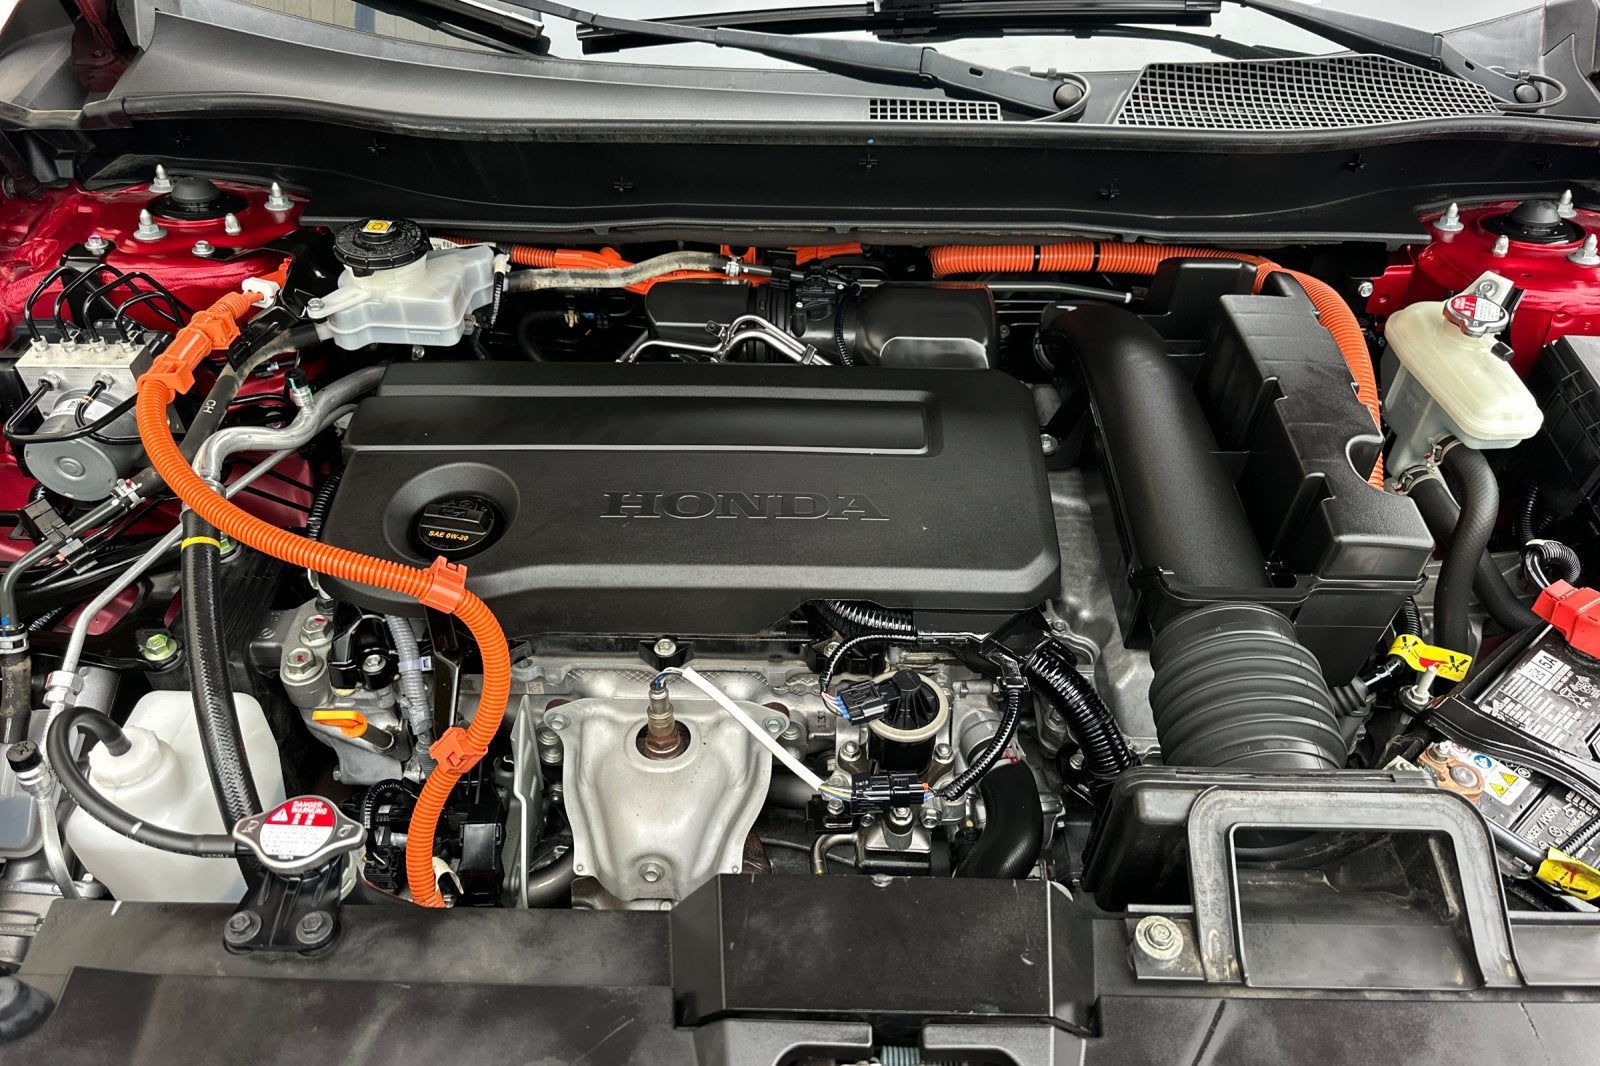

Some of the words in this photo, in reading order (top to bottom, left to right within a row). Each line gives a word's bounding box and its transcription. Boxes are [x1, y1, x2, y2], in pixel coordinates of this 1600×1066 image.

[202, 399, 217, 414] CH
[600, 490, 890, 521] HONDA
[428, 530, 445, 538] SAE
[445, 532, 469, 541] 0W-20
[1538, 655, 1558, 669] 5A
[292, 800, 324, 809] DANGER
